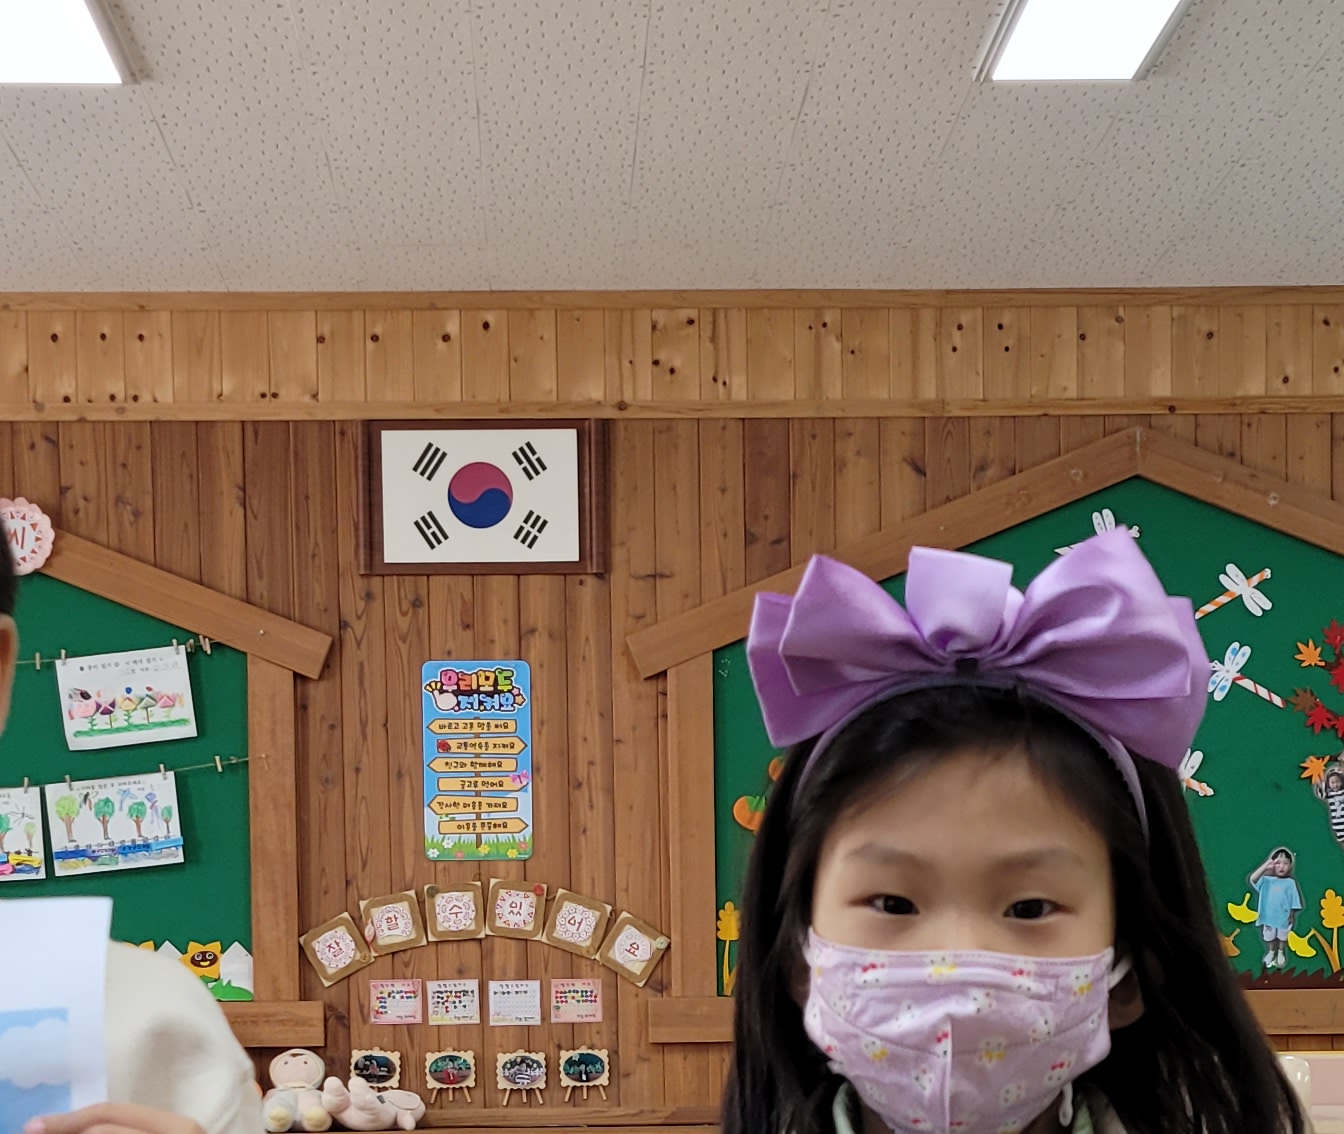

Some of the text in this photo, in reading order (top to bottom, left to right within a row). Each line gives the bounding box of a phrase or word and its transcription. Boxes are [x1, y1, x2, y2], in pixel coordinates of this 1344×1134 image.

[440, 667, 515, 693] 우리모두
[456, 692, 516, 712] 지켜요
[445, 761, 467, 769] 친구와
[460, 780, 504, 789] 골고루 먹어요
[326, 941, 345, 959] 잘
[385, 916, 400, 932] 할
[448, 902, 464, 919] 수
